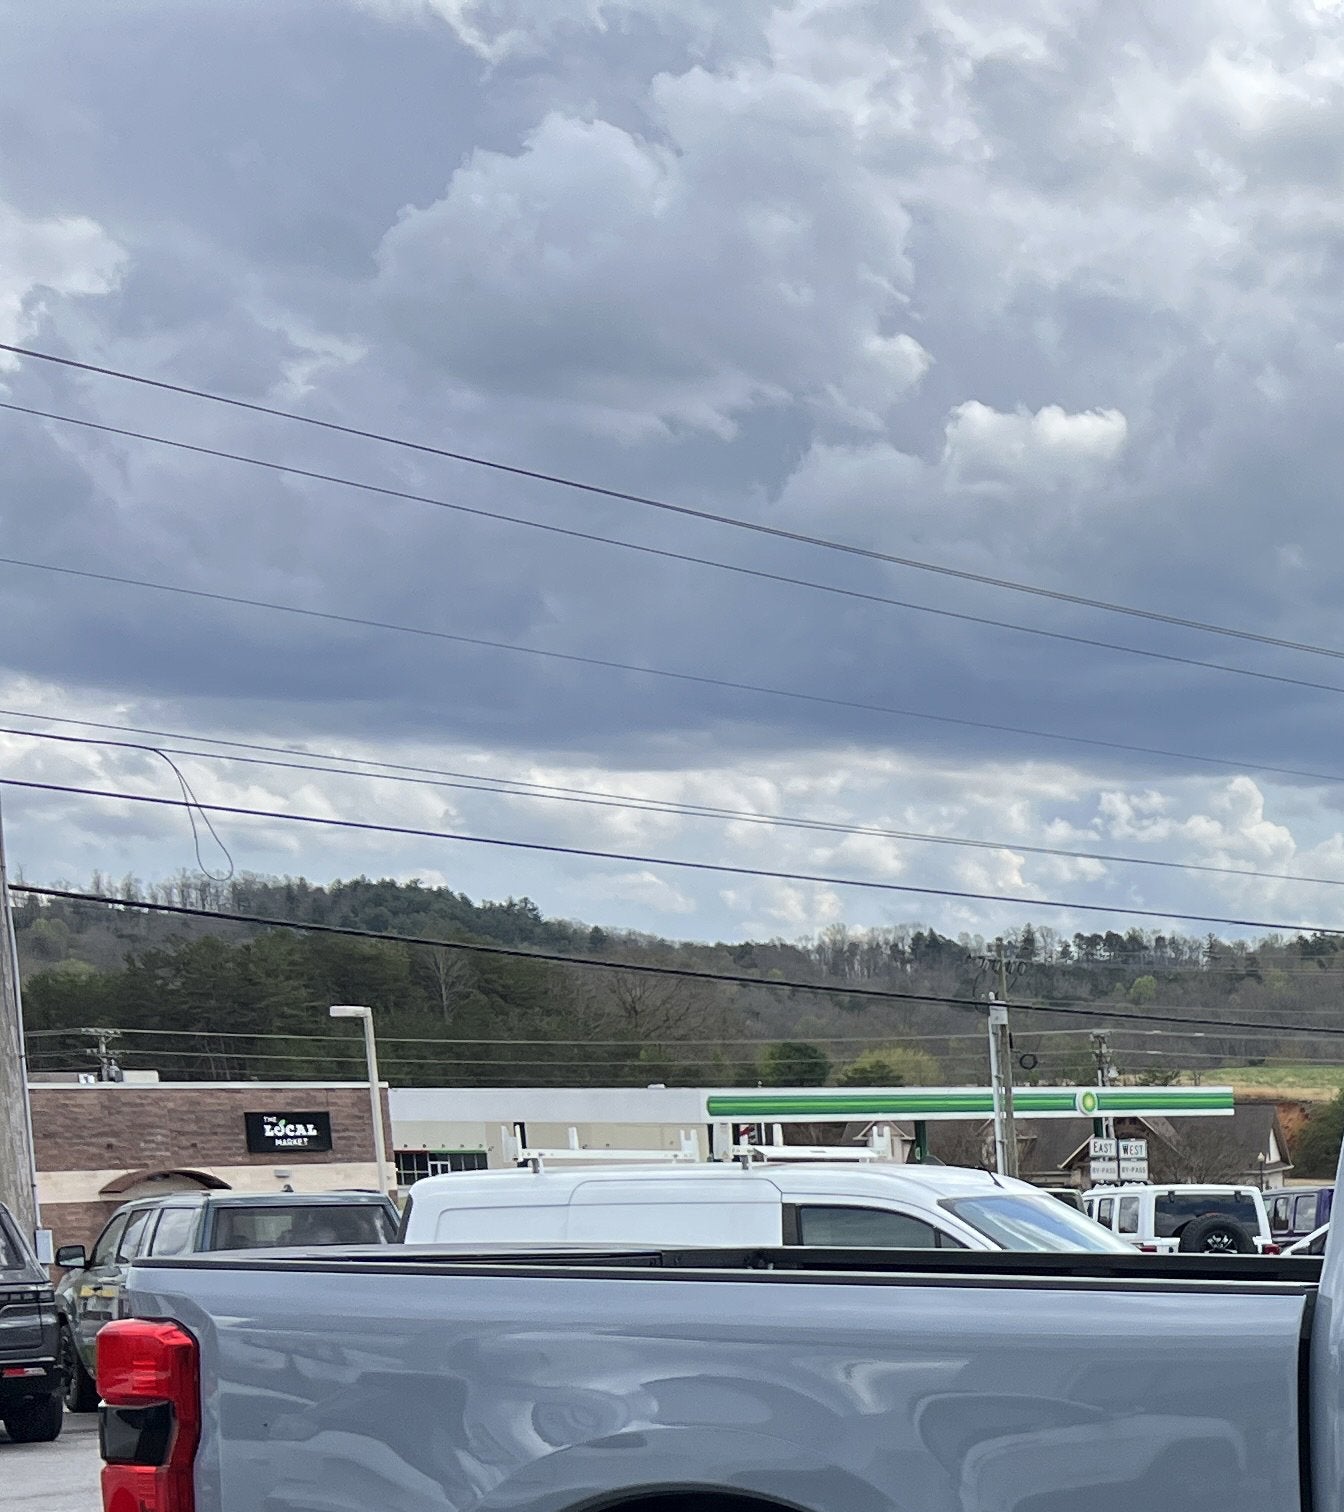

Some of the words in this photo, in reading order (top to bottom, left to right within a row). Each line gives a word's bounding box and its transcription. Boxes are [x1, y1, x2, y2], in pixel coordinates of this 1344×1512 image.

[263, 1123, 318, 1137] LOCAL
[275, 1138, 308, 1146] MARKET
[1093, 1141, 1113, 1153] EAST
[1122, 1144, 1143, 1155] WEST
[1122, 1166, 1146, 1174] BY-PASS
